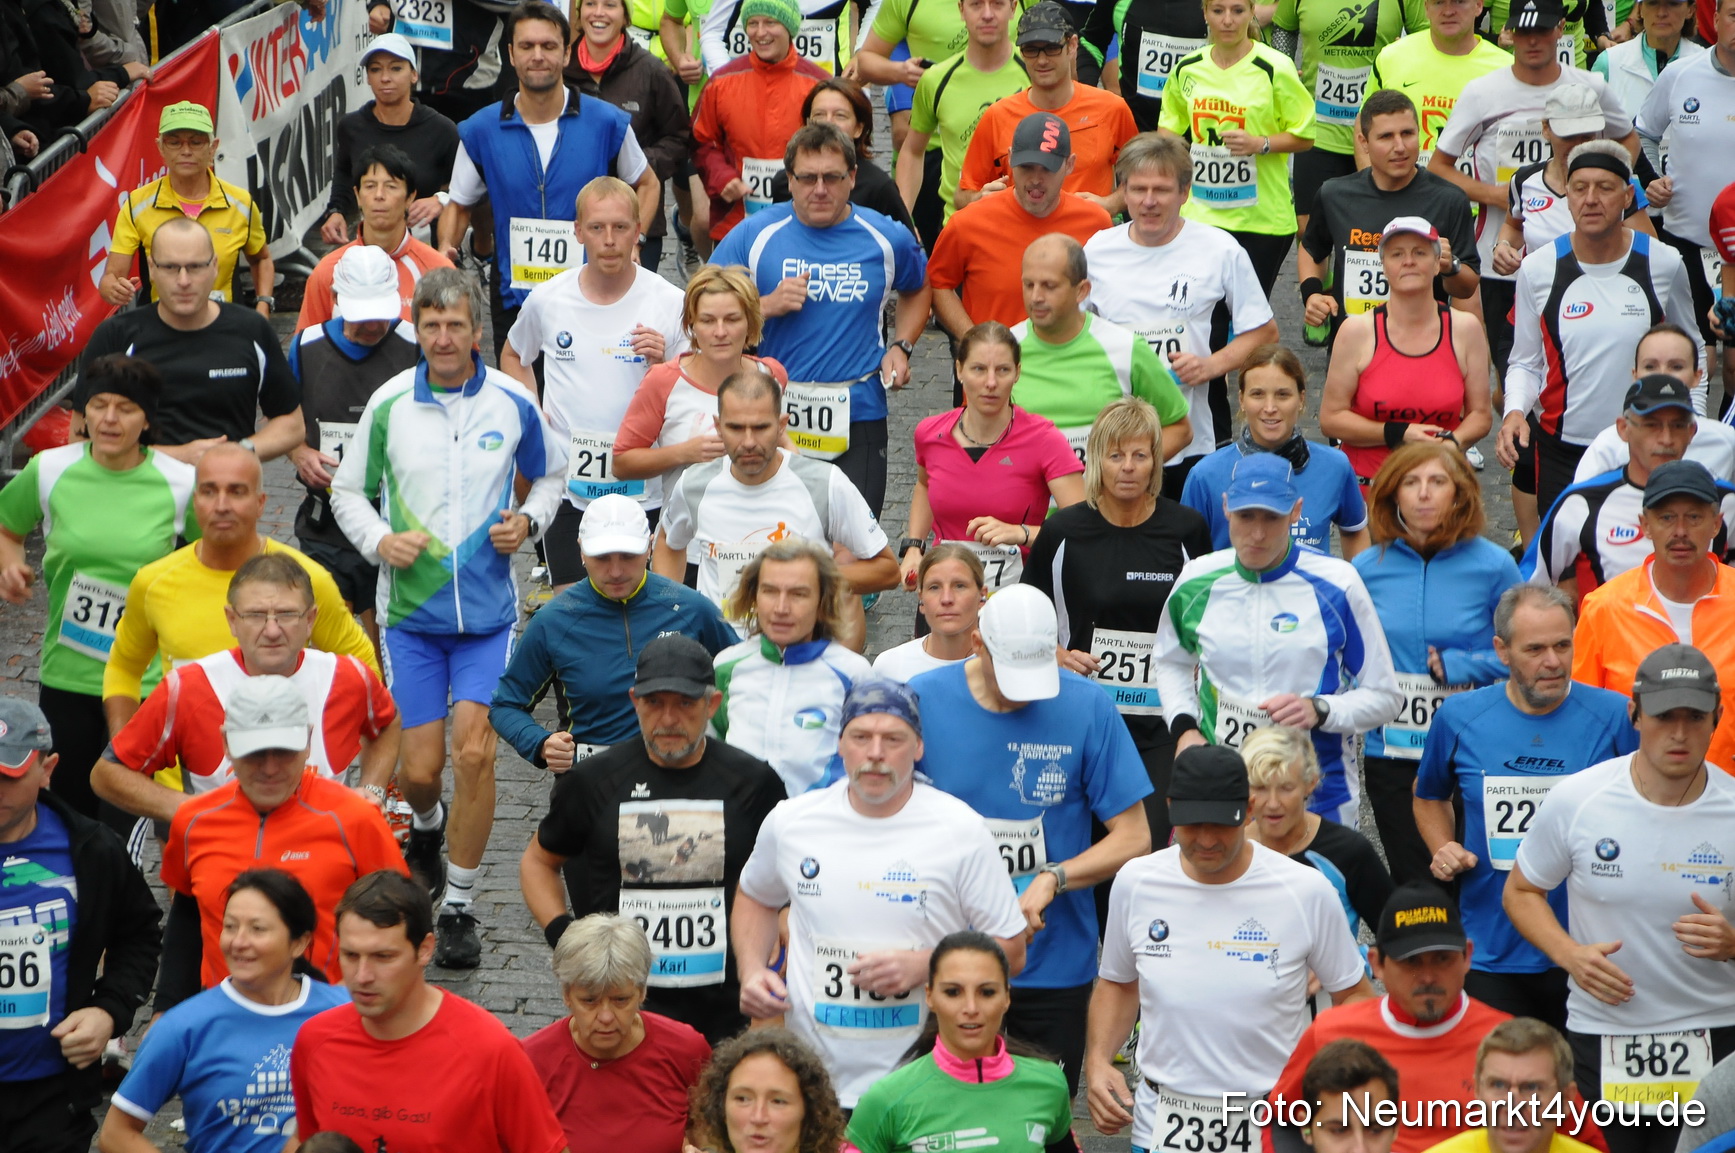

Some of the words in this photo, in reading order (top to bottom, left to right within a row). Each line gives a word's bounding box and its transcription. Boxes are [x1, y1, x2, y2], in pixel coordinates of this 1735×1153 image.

[1318, 14, 1347, 42] GOSSEN
[1142, 39, 1164, 48] PARTL
[1165, 43, 1198, 52] Neumarkt
[1324, 49, 1375, 58] METRAWATT
[1193, 98, 1246, 116] Müller
[1194, 160, 1251, 184] 2026
[1206, 189, 1239, 200] Monika
[511, 224, 534, 233] PARTL
[535, 226, 571, 235] Neumarkt
[524, 236, 568, 264] 140
[782, 257, 862, 280] Fitness
[1346, 257, 1371, 266] PARTL
[1359, 269, 1390, 296] 35
[778, 279, 869, 302] RNER
[1566, 303, 1587, 314] tkn
[787, 402, 834, 432] 510
[1374, 401, 1453, 424] Freya
[322, 430, 343, 439] PARTL
[572, 437, 599, 448] PARTL
[796, 435, 822, 449] Josef
[576, 450, 607, 479] 21
[587, 483, 629, 498] Manfred
[1610, 526, 1635, 538] tkn
[718, 552, 746, 561] PARTL
[1134, 573, 1174, 583] PFLEIDERER
[1094, 636, 1125, 648] PARTL
[1097, 651, 1151, 684] 251
[1115, 690, 1147, 704] Heidi
[1019, 750, 1062, 761] STADTLAUF
[1020, 743, 1073, 755] NEUMARKTER
[1514, 756, 1566, 769] ERTEL
[1487, 786, 1519, 796] PARTL
[1495, 800, 1544, 834] 22
[1591, 862, 1624, 874] PARTL
[657, 899, 707, 911] Neumarkt
[816, 945, 850, 958] PARTL
[1144, 944, 1173, 954] PARTL
[659, 958, 686, 974] Karl
[824, 1004, 905, 1027] FRANK
[1624, 1041, 1692, 1077] 582
[1613, 1085, 1675, 1103] Michael
[1159, 1095, 1191, 1111] PARTL
[396, 1108, 432, 1124] Gas!
[1162, 1112, 1252, 1153] 2334
